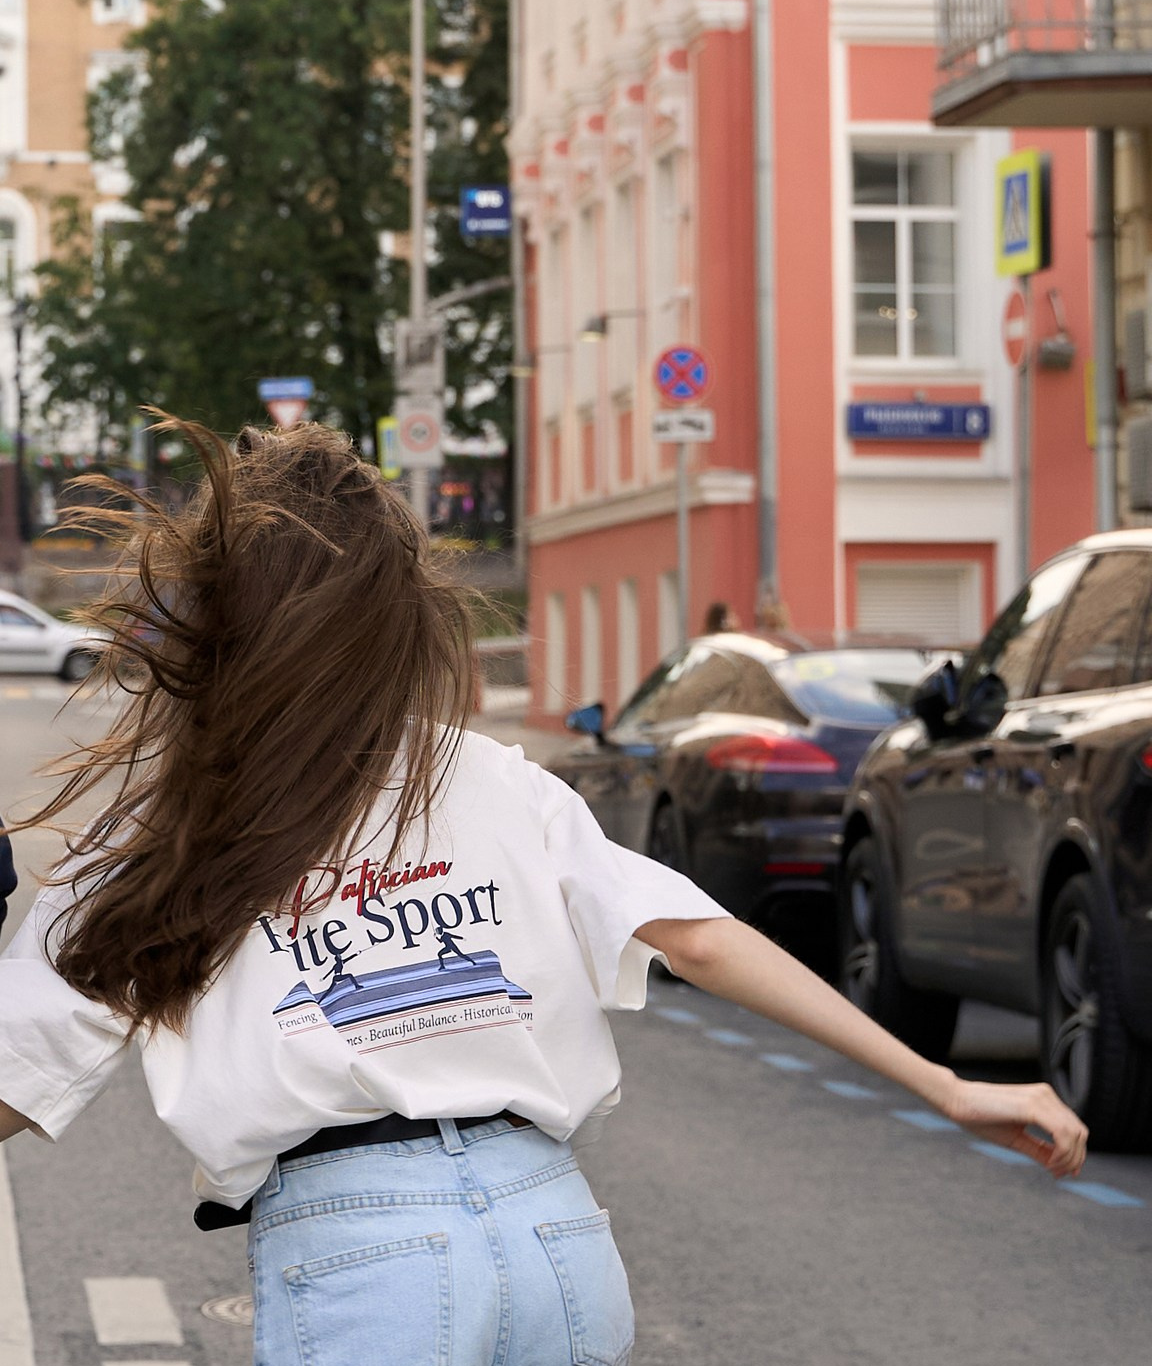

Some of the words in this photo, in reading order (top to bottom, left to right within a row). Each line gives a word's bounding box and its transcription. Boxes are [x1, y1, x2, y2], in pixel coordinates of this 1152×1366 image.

[275, 858, 453, 940] Patrician
[362, 879, 503, 950] Sport
[278, 1013, 318, 1030] Fencing
[369, 1019, 416, 1041] Beautiful
[418, 1014, 457, 1030] Balance
